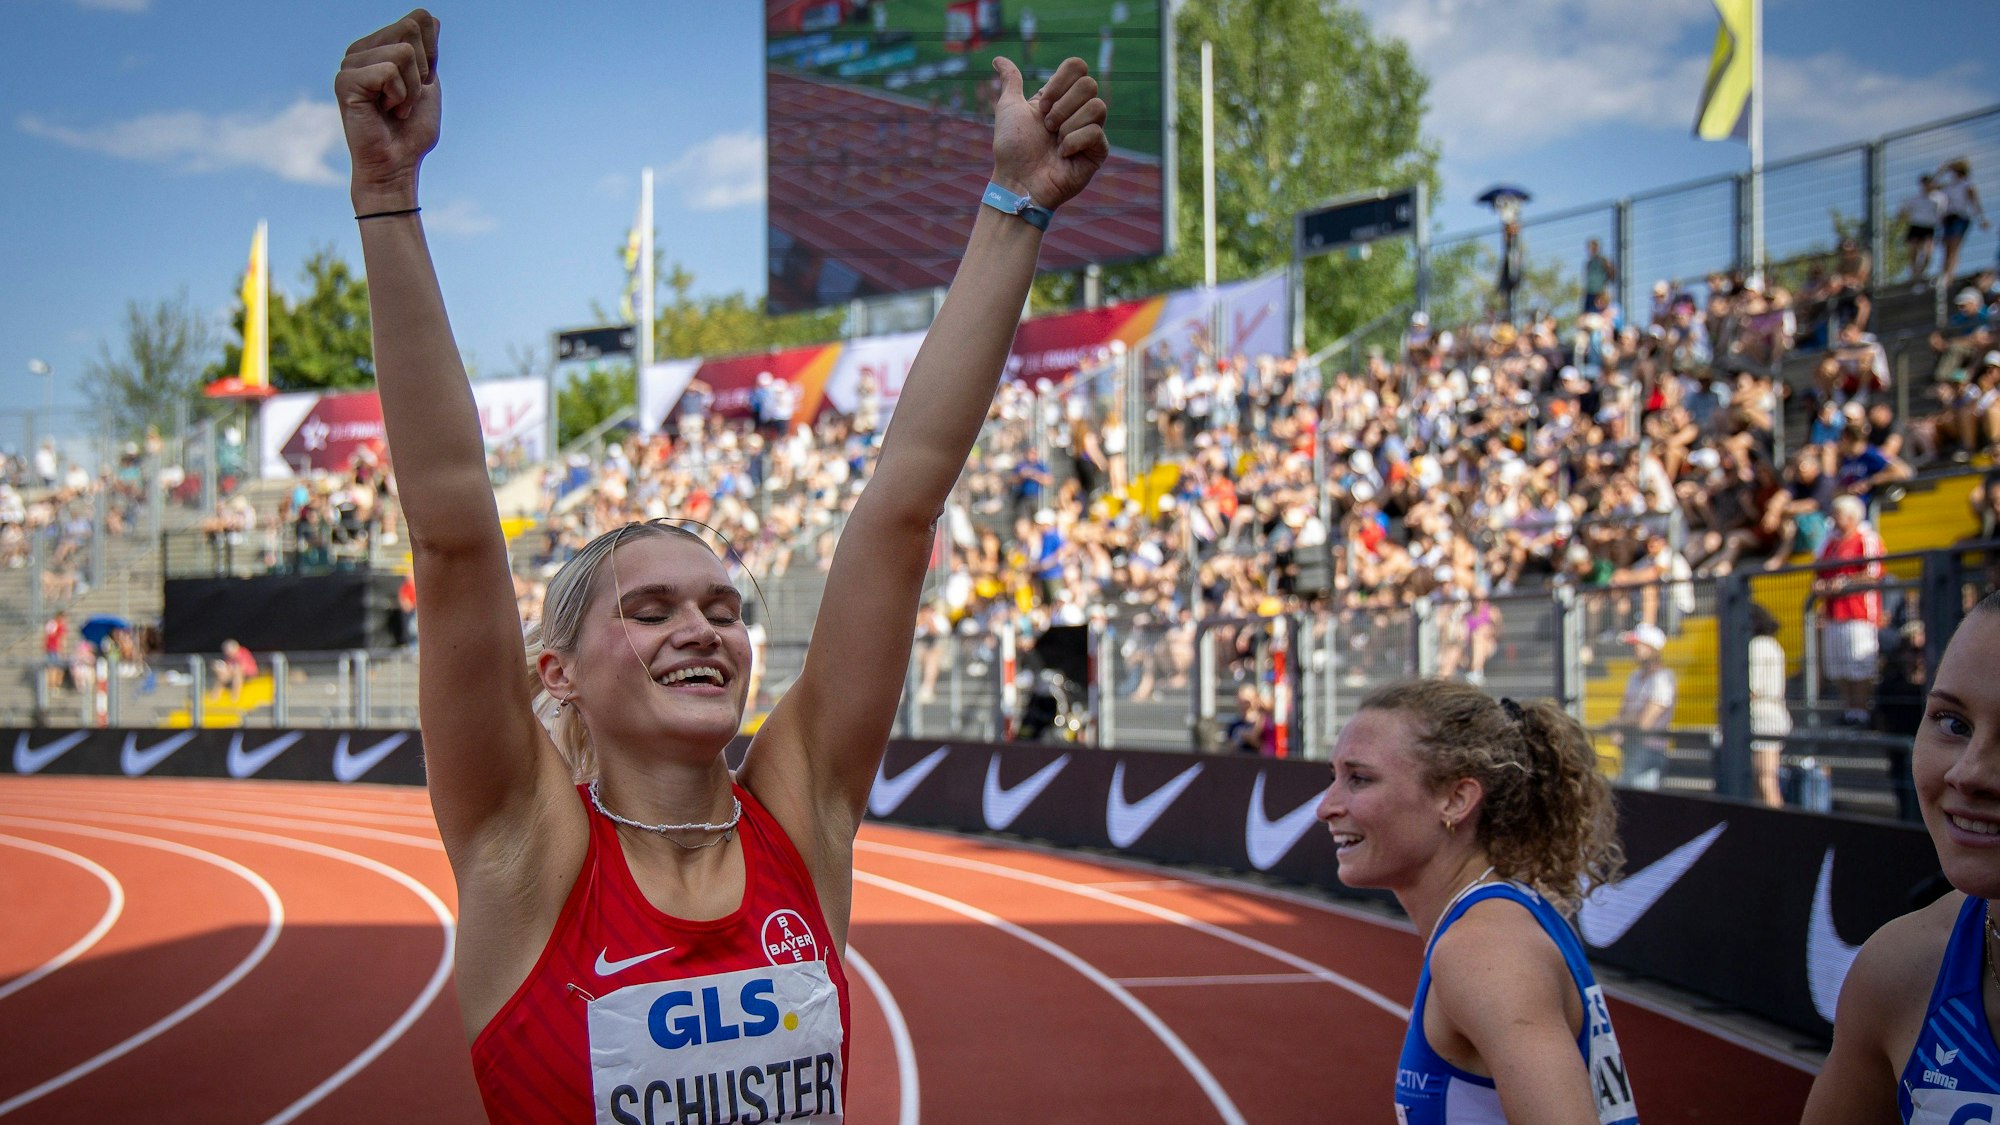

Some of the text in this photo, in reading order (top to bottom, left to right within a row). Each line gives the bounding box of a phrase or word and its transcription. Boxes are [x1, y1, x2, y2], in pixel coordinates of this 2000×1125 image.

[768, 934, 813, 956] BAYER
[776, 915, 802, 962] BAYE
[610, 1052, 836, 1125] SCHUSTER
[1923, 1068, 1959, 1090] erima
